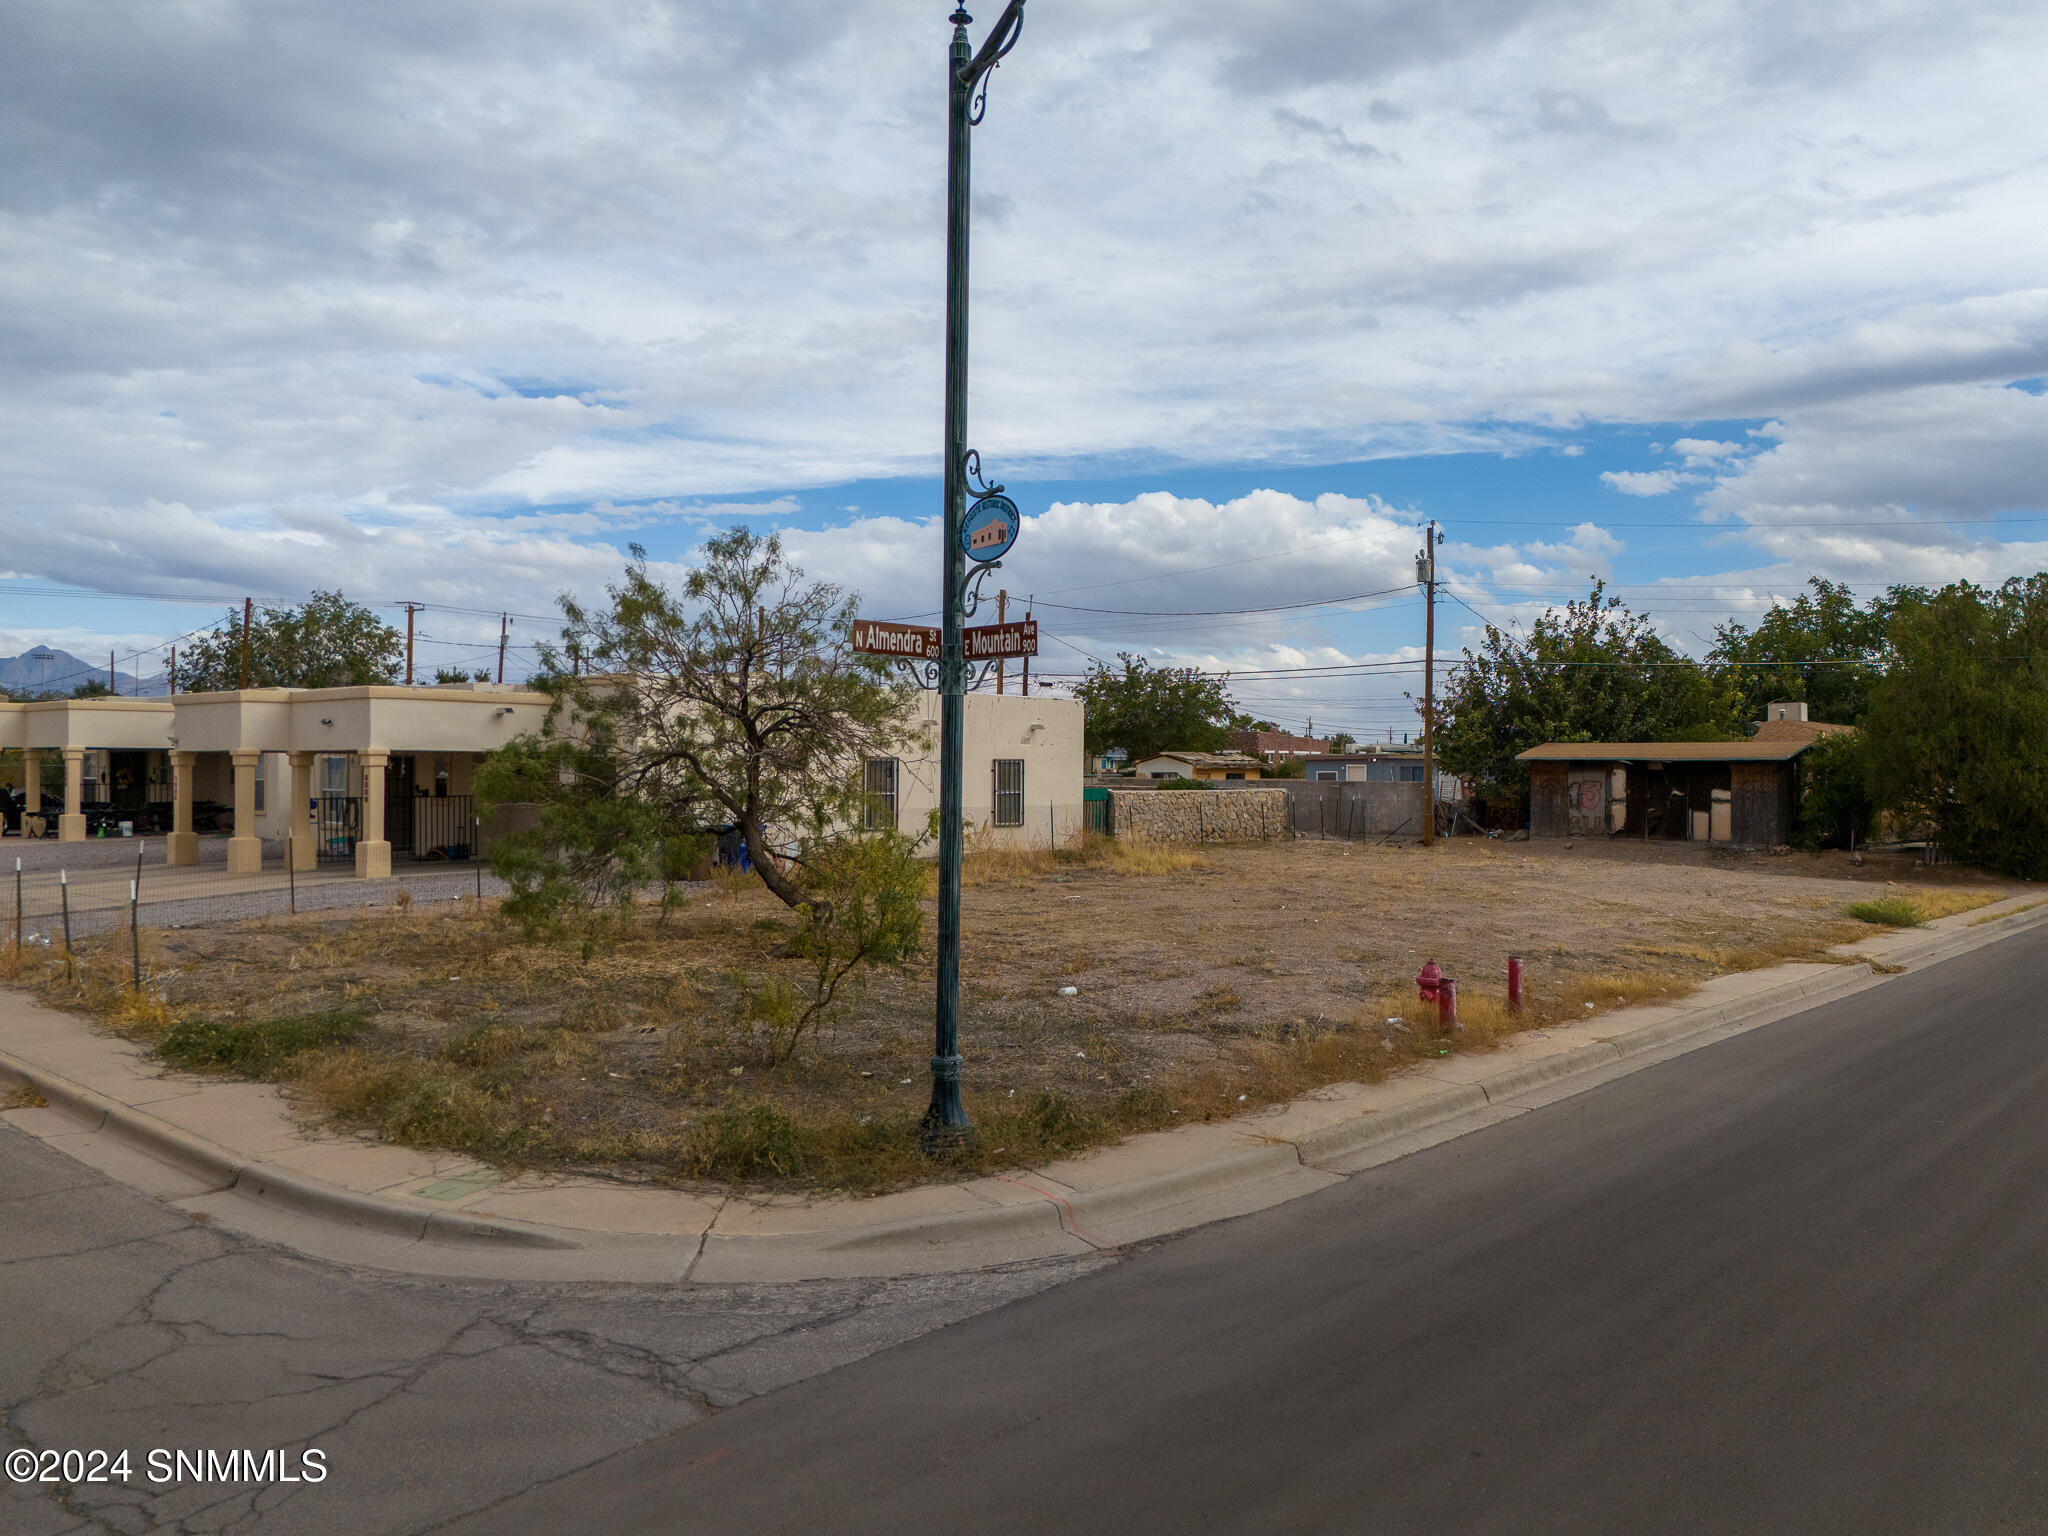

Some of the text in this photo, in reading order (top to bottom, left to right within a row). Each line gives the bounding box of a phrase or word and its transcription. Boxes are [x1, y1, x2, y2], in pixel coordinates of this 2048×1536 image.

[929, 629, 937, 642] St
[1022, 622, 1035, 636] Ave
[855, 624, 923, 654] N Almendra
[964, 627, 1021, 656] E Mountain
[1022, 638, 1036, 652] 900
[926, 644, 940, 657] 600
